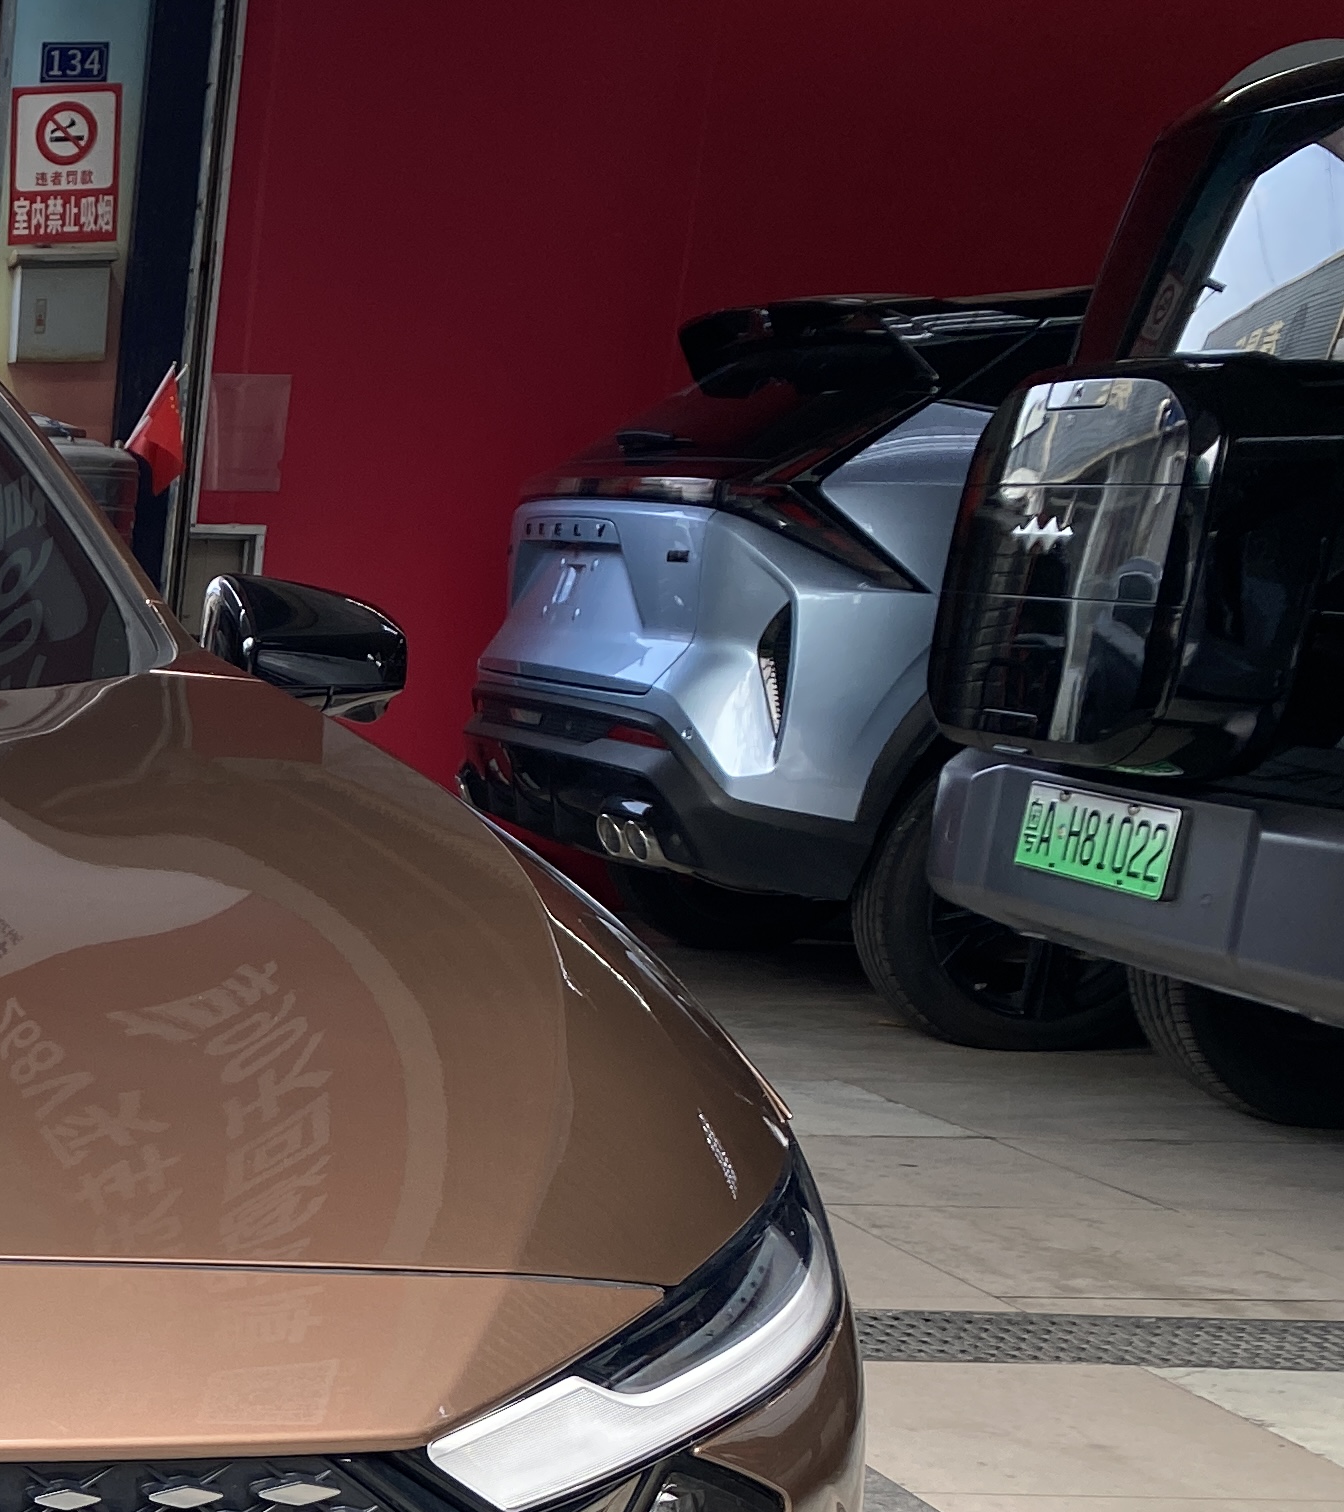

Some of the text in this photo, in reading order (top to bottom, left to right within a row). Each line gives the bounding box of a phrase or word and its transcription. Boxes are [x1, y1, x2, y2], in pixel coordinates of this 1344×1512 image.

[48, 49, 101, 76] 134
[34, 169, 94, 187] 违者罚款
[12, 194, 114, 235] 室内禁止吸烟
[525, 522, 606, 538] GEELY
